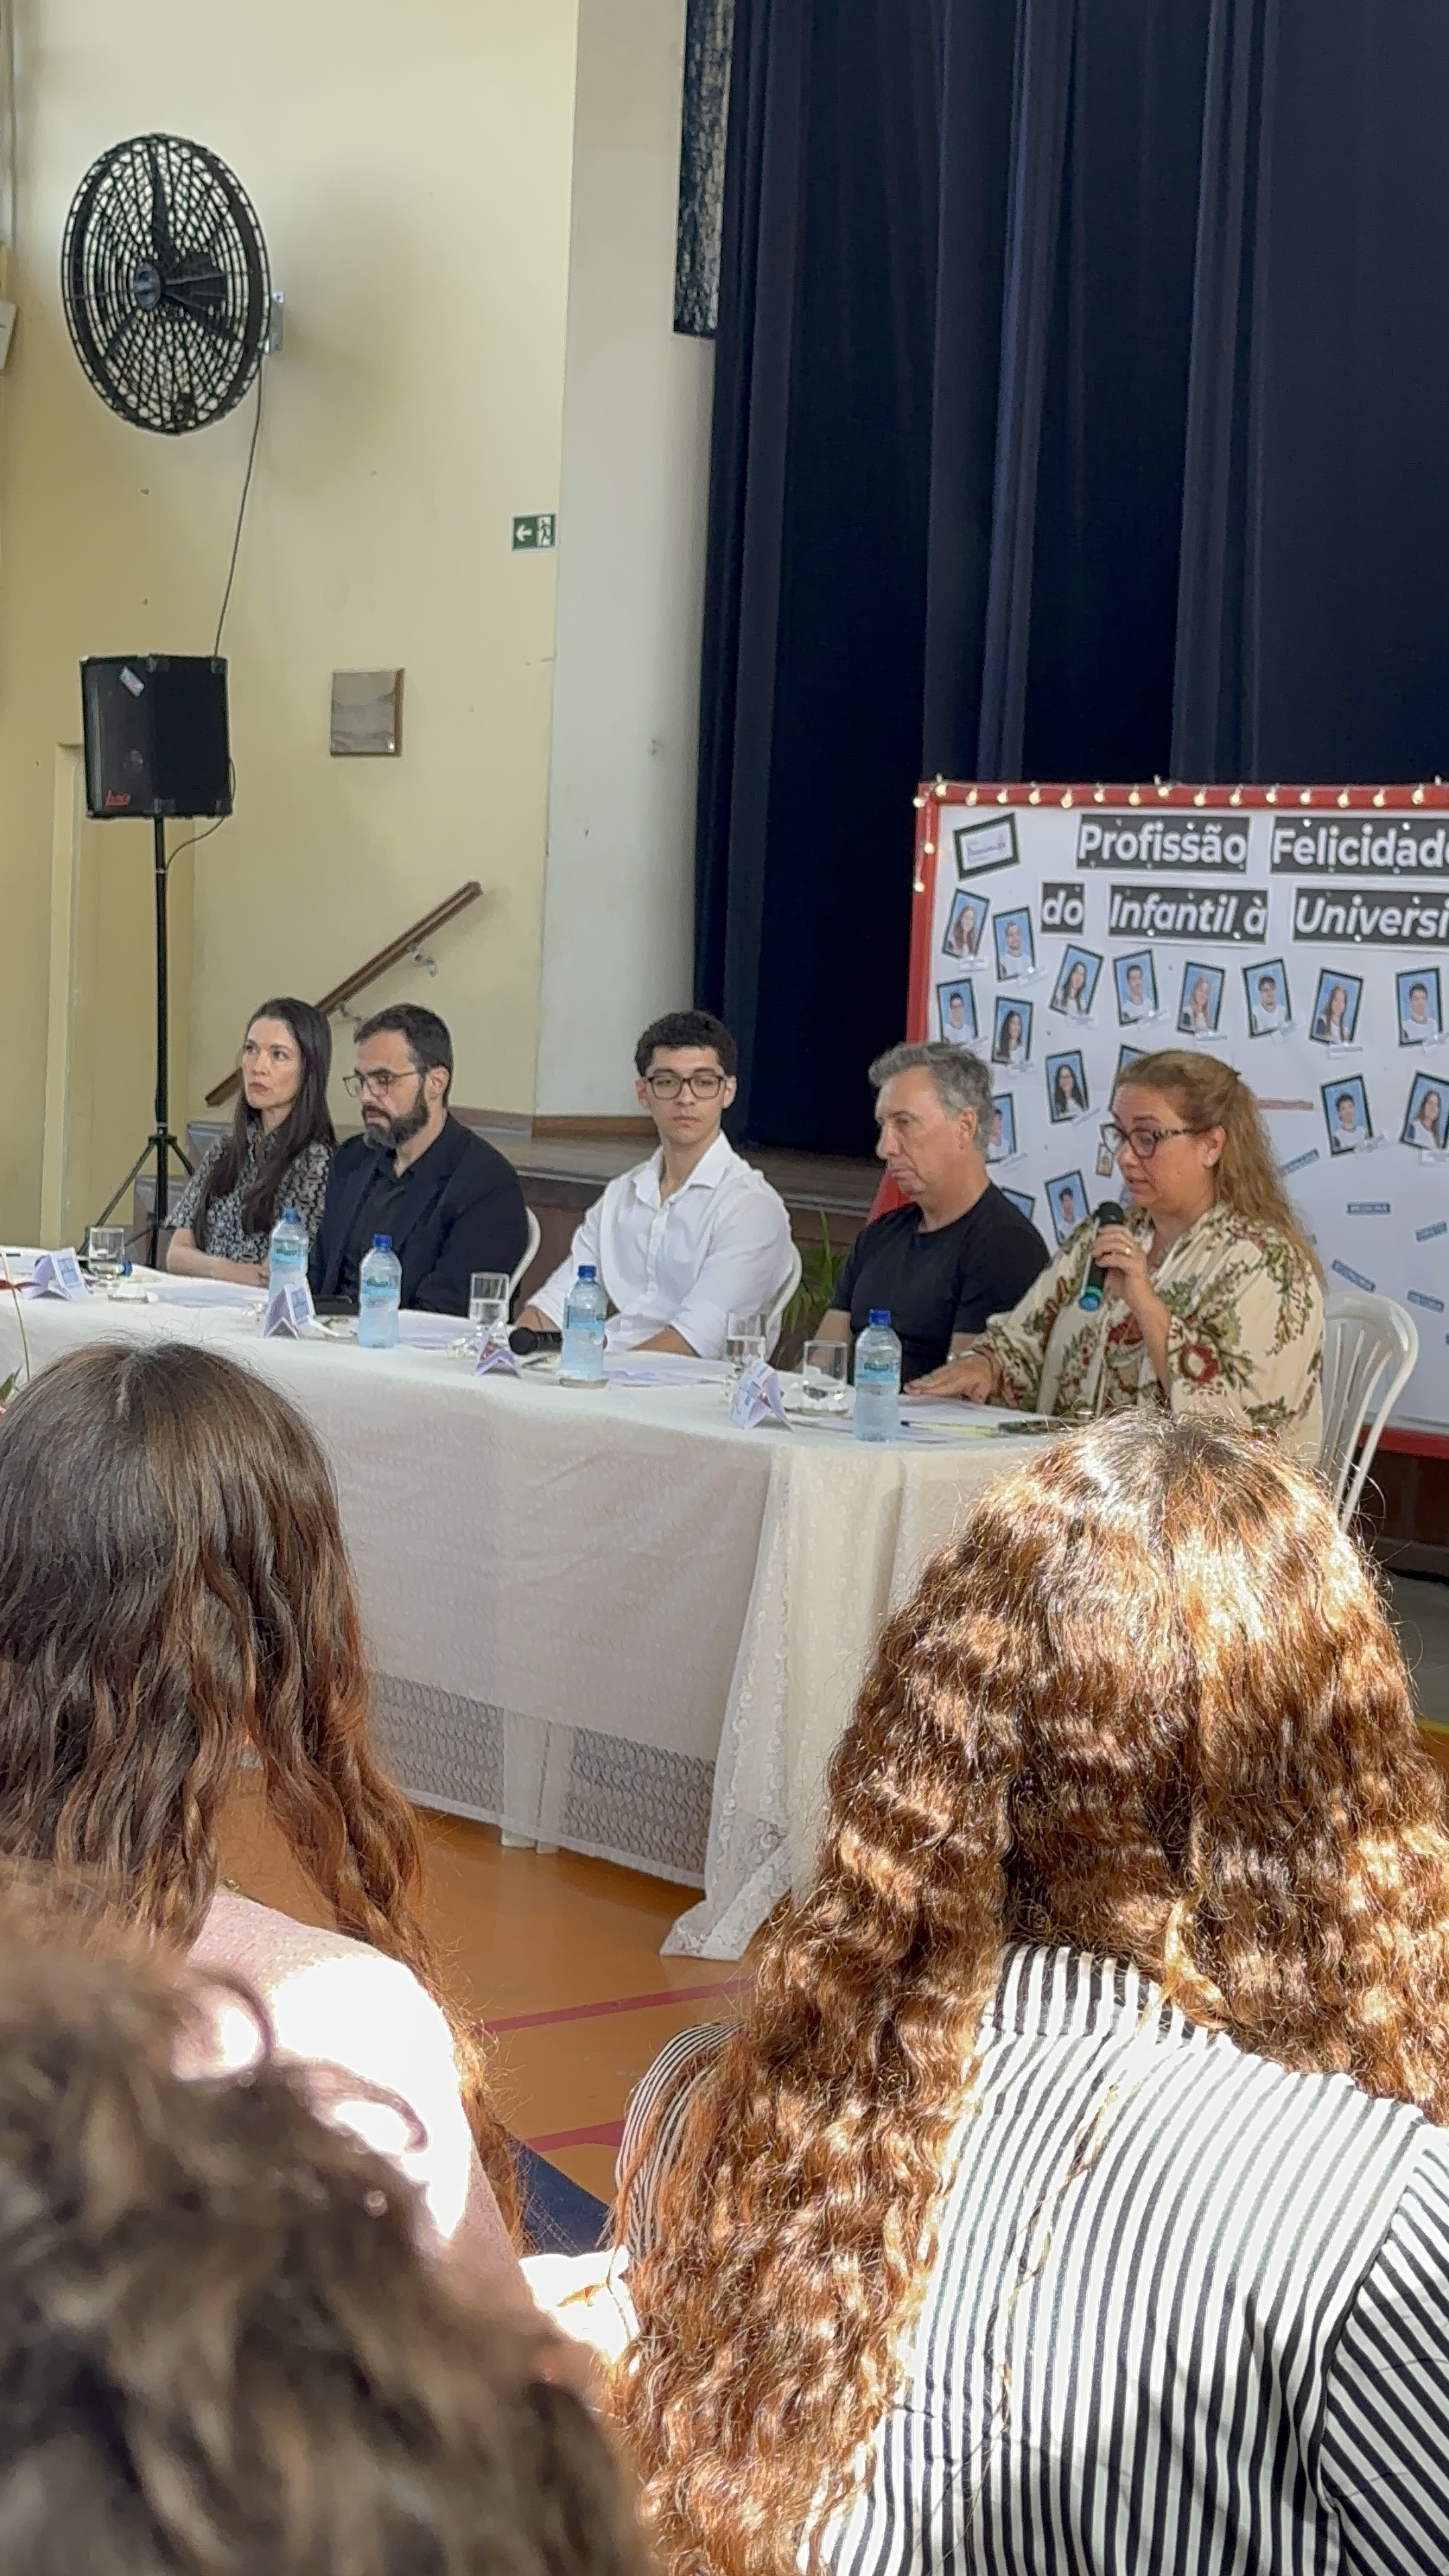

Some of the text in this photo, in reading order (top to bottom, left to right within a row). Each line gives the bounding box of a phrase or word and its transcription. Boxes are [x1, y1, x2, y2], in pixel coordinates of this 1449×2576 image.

[1078, 820, 1449, 868] Profissão Felicidad
[1043, 889, 1449, 938] do Infantil à Universi
